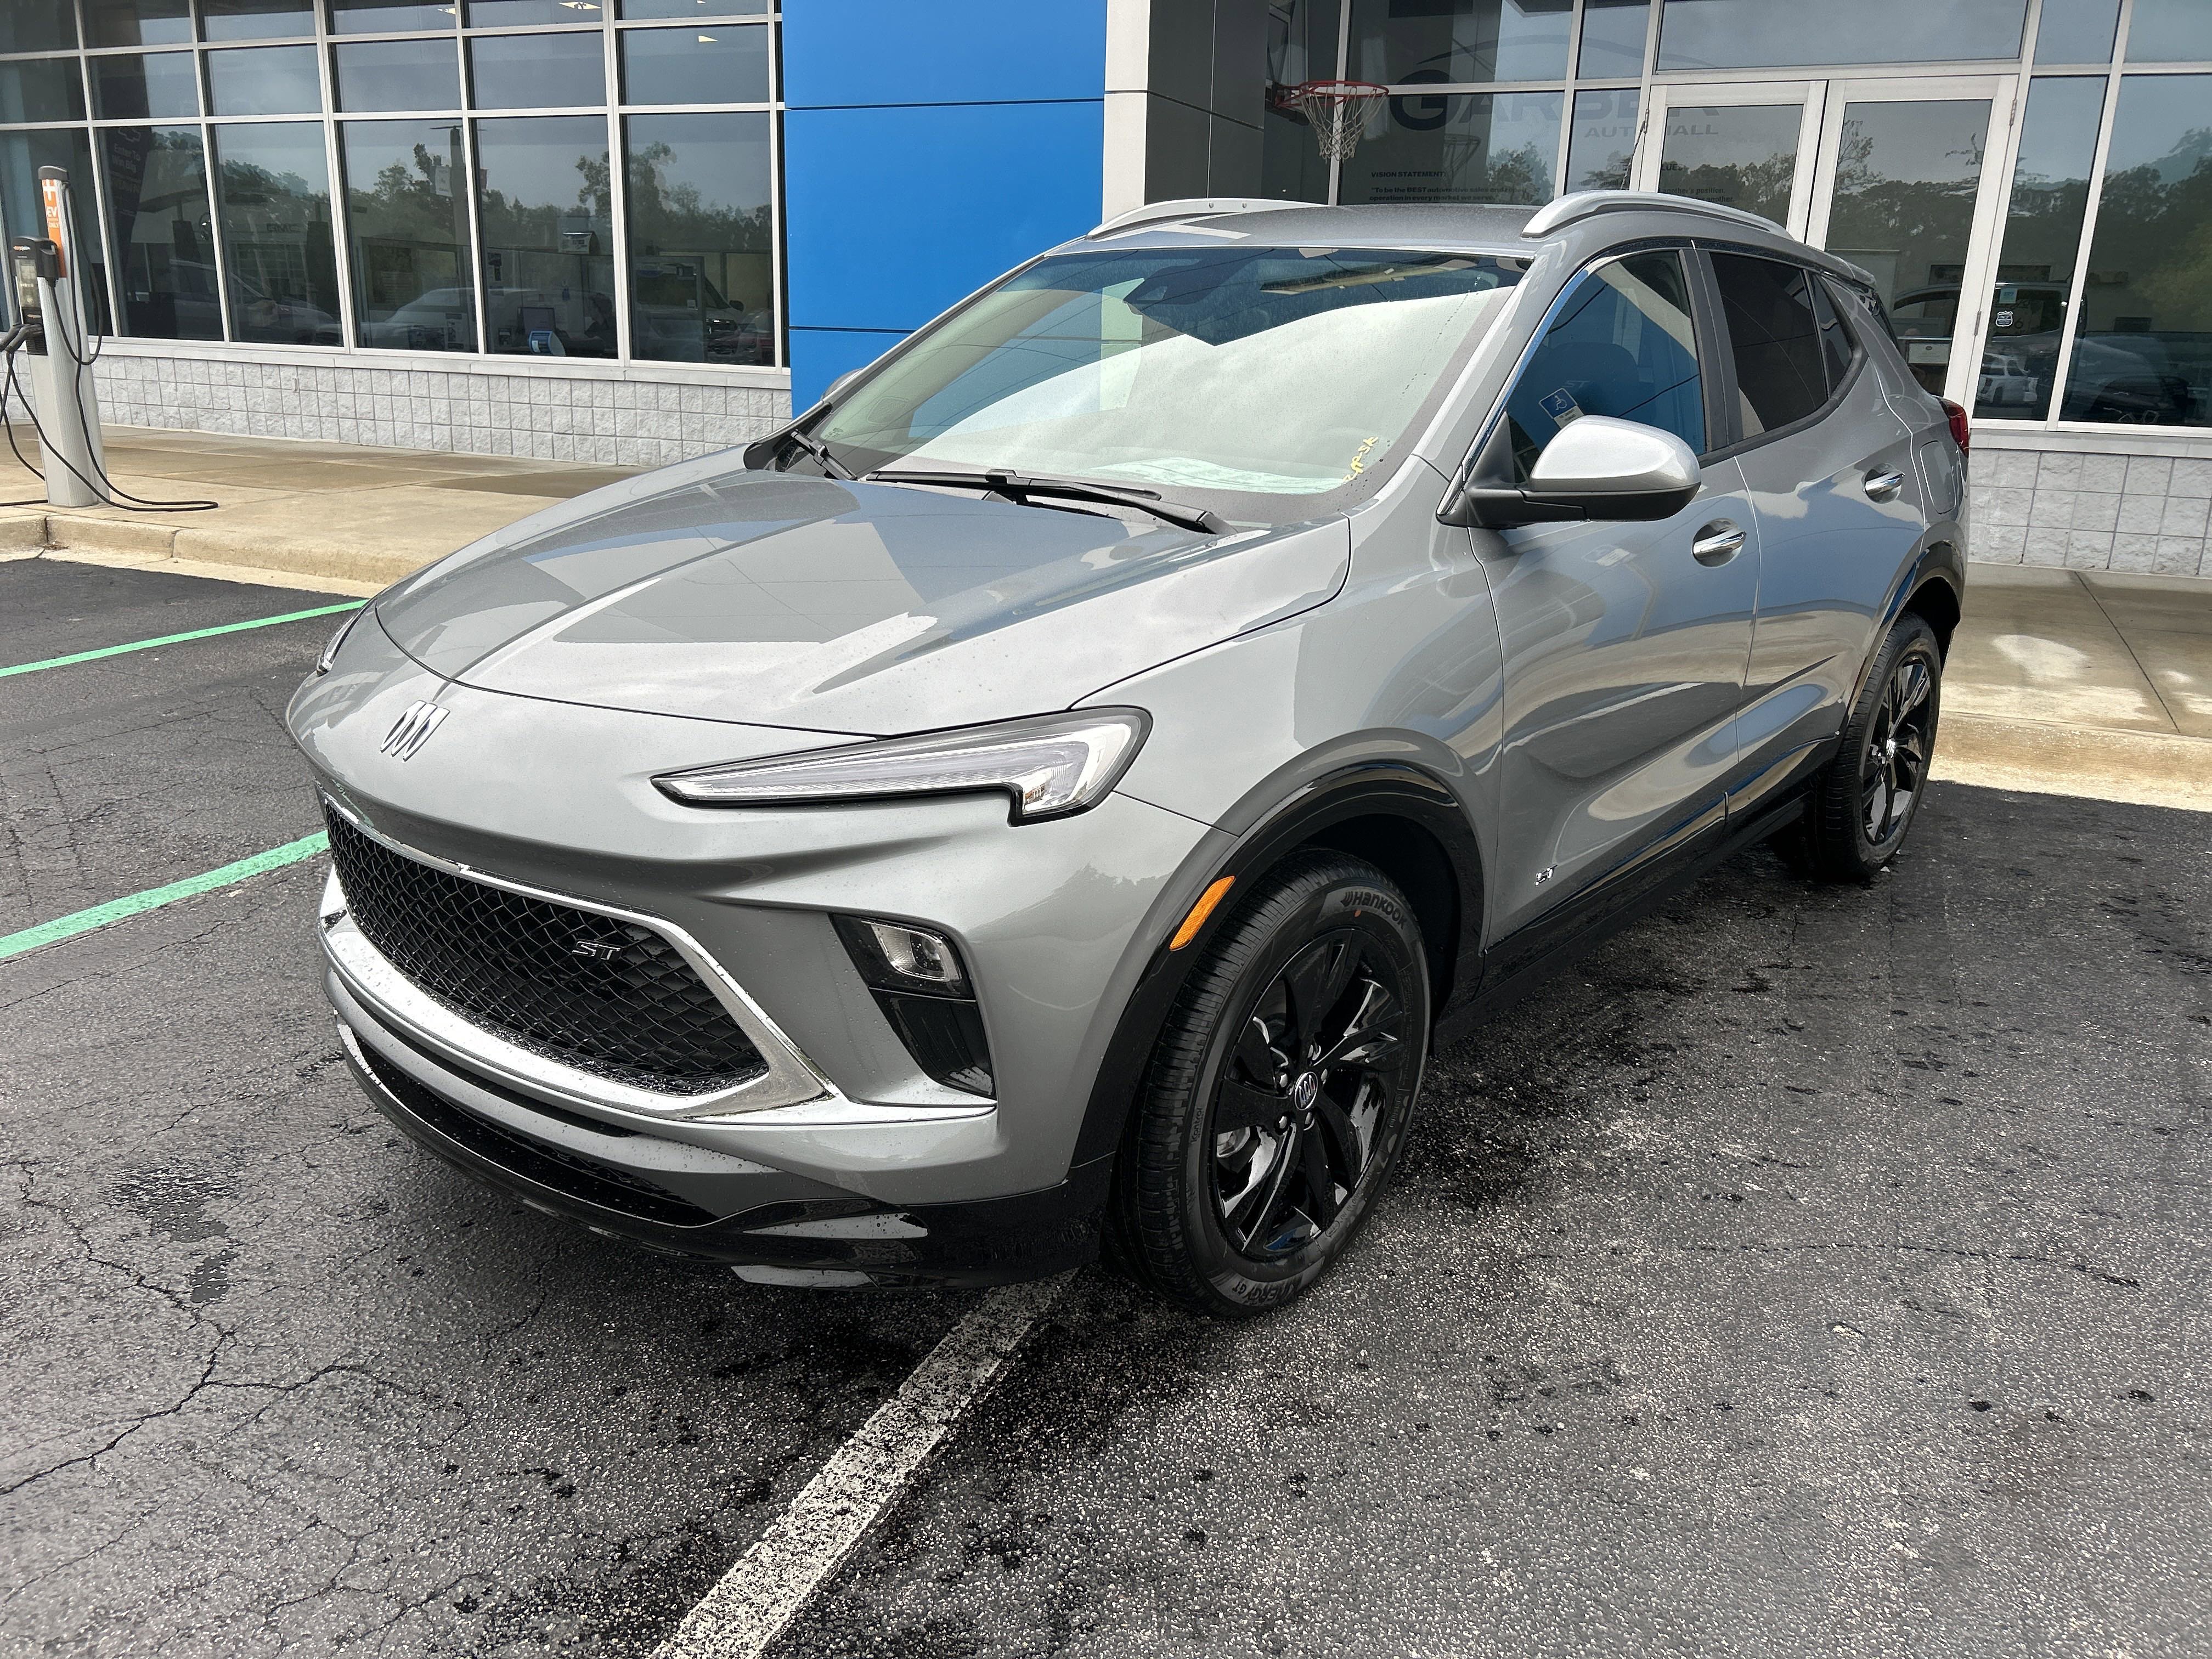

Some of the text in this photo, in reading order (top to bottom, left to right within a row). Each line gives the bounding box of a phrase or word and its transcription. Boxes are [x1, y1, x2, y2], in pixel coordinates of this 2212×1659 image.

[1389, 69, 1720, 131] GARBE
[1584, 127, 1639, 138] AUT
[47, 206, 58, 218] EV
[571, 939, 623, 961] ST
